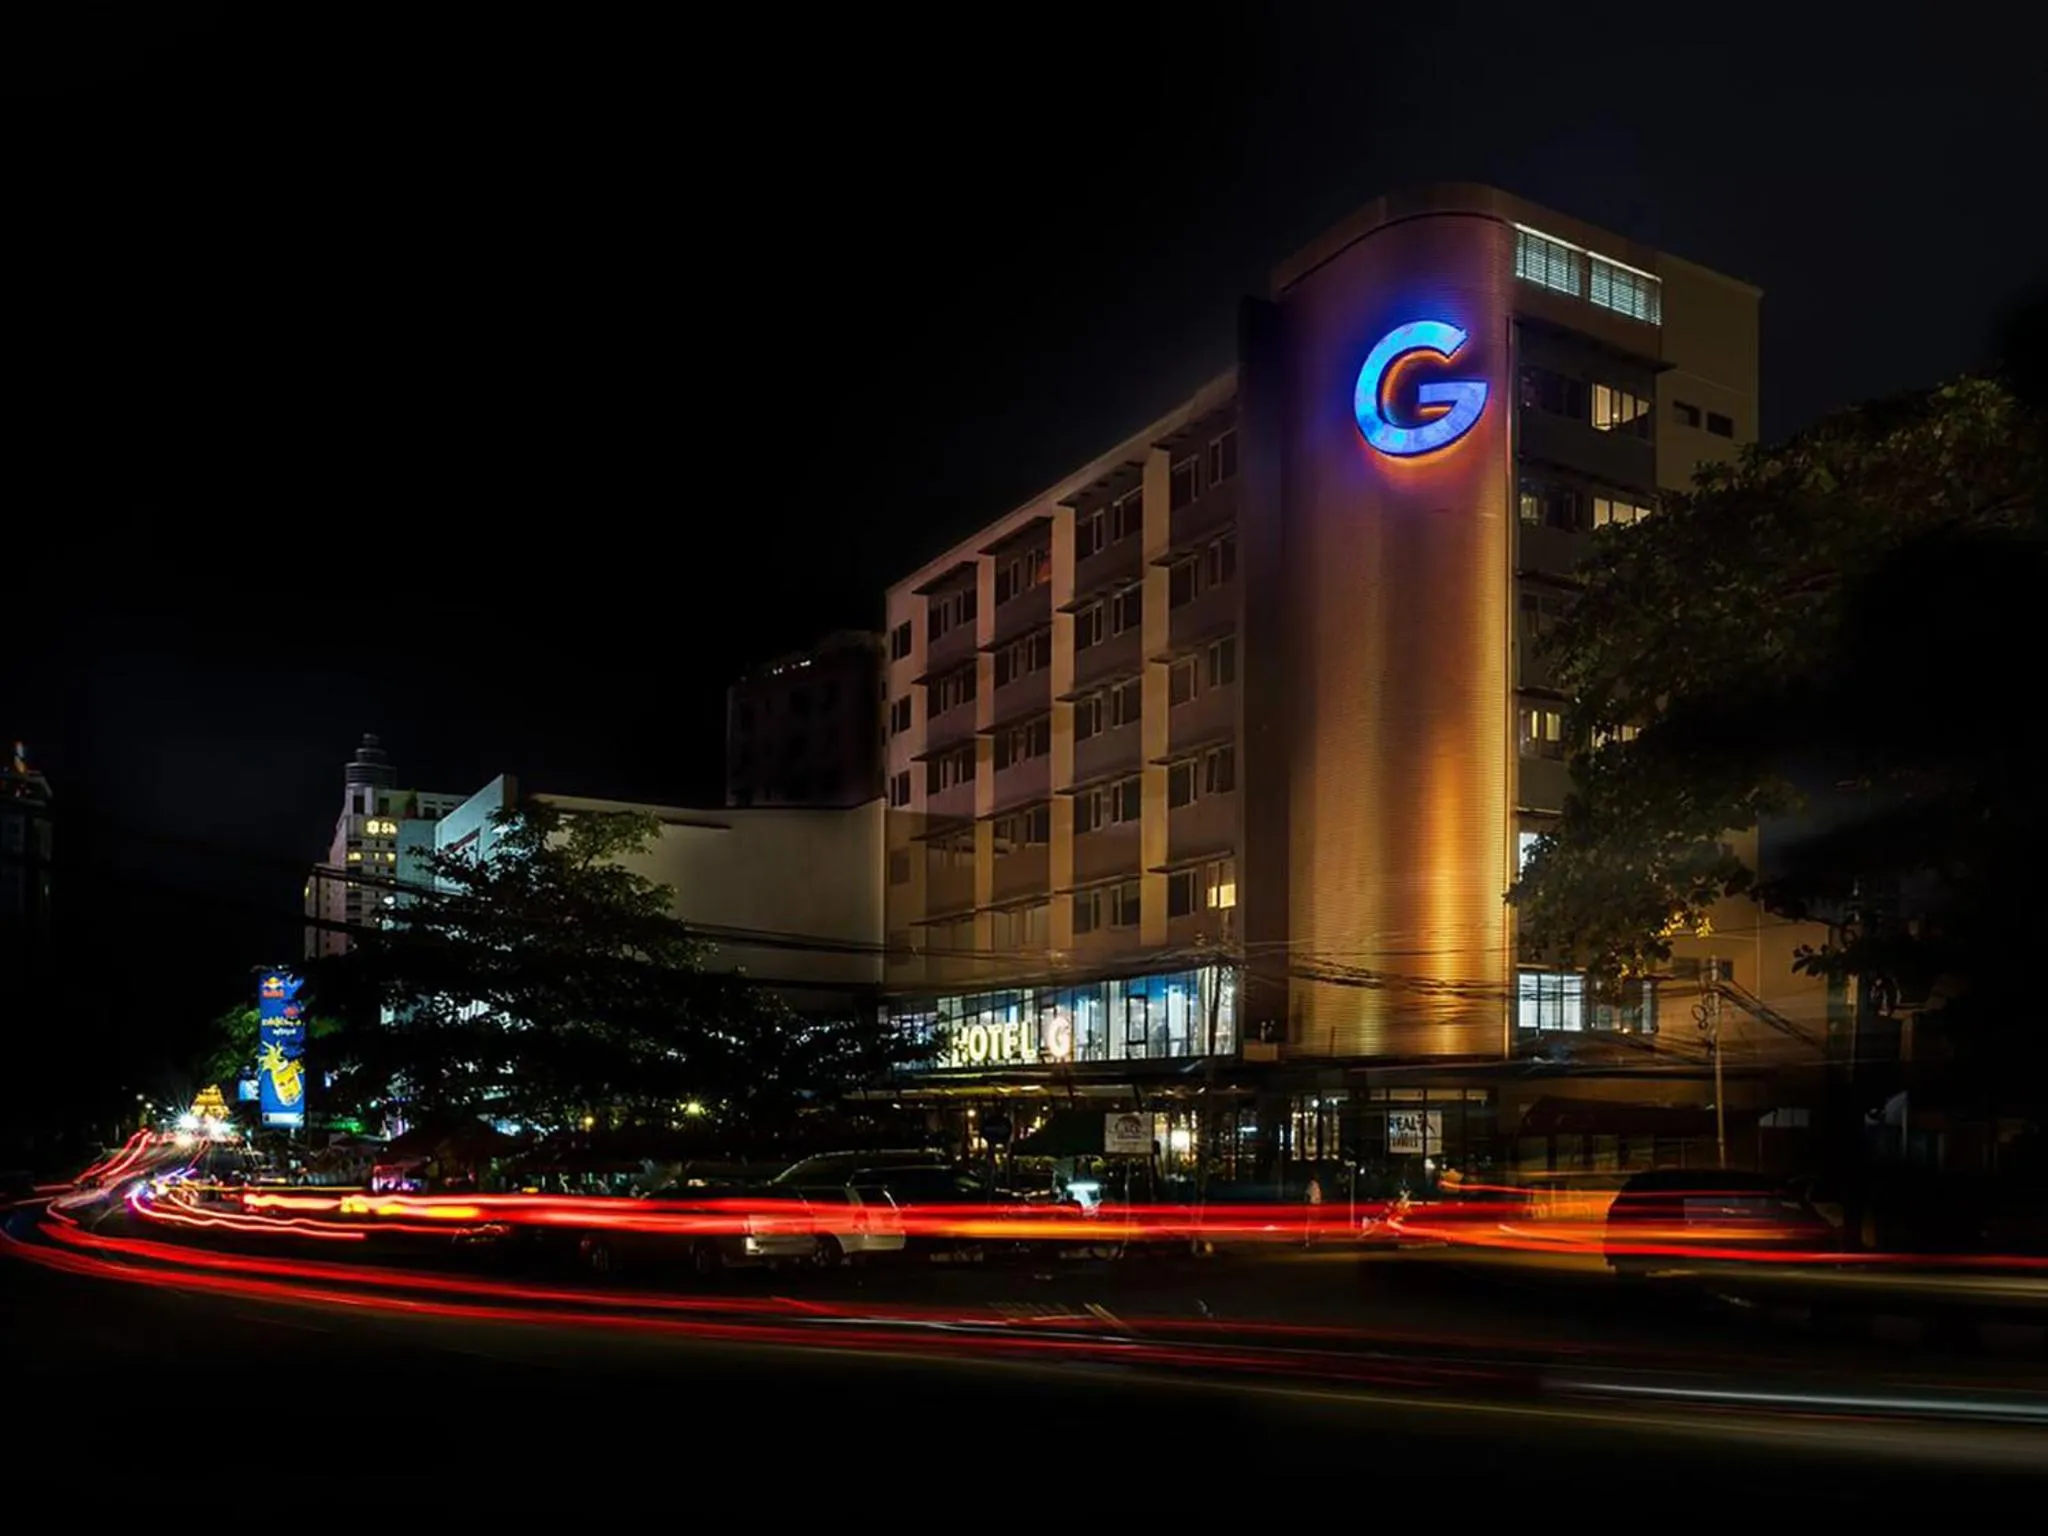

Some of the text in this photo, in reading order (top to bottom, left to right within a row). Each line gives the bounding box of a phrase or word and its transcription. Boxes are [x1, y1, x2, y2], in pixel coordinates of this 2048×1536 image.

[1354, 320, 1488, 454] G
[952, 1016, 1071, 1064] HOTEL G
